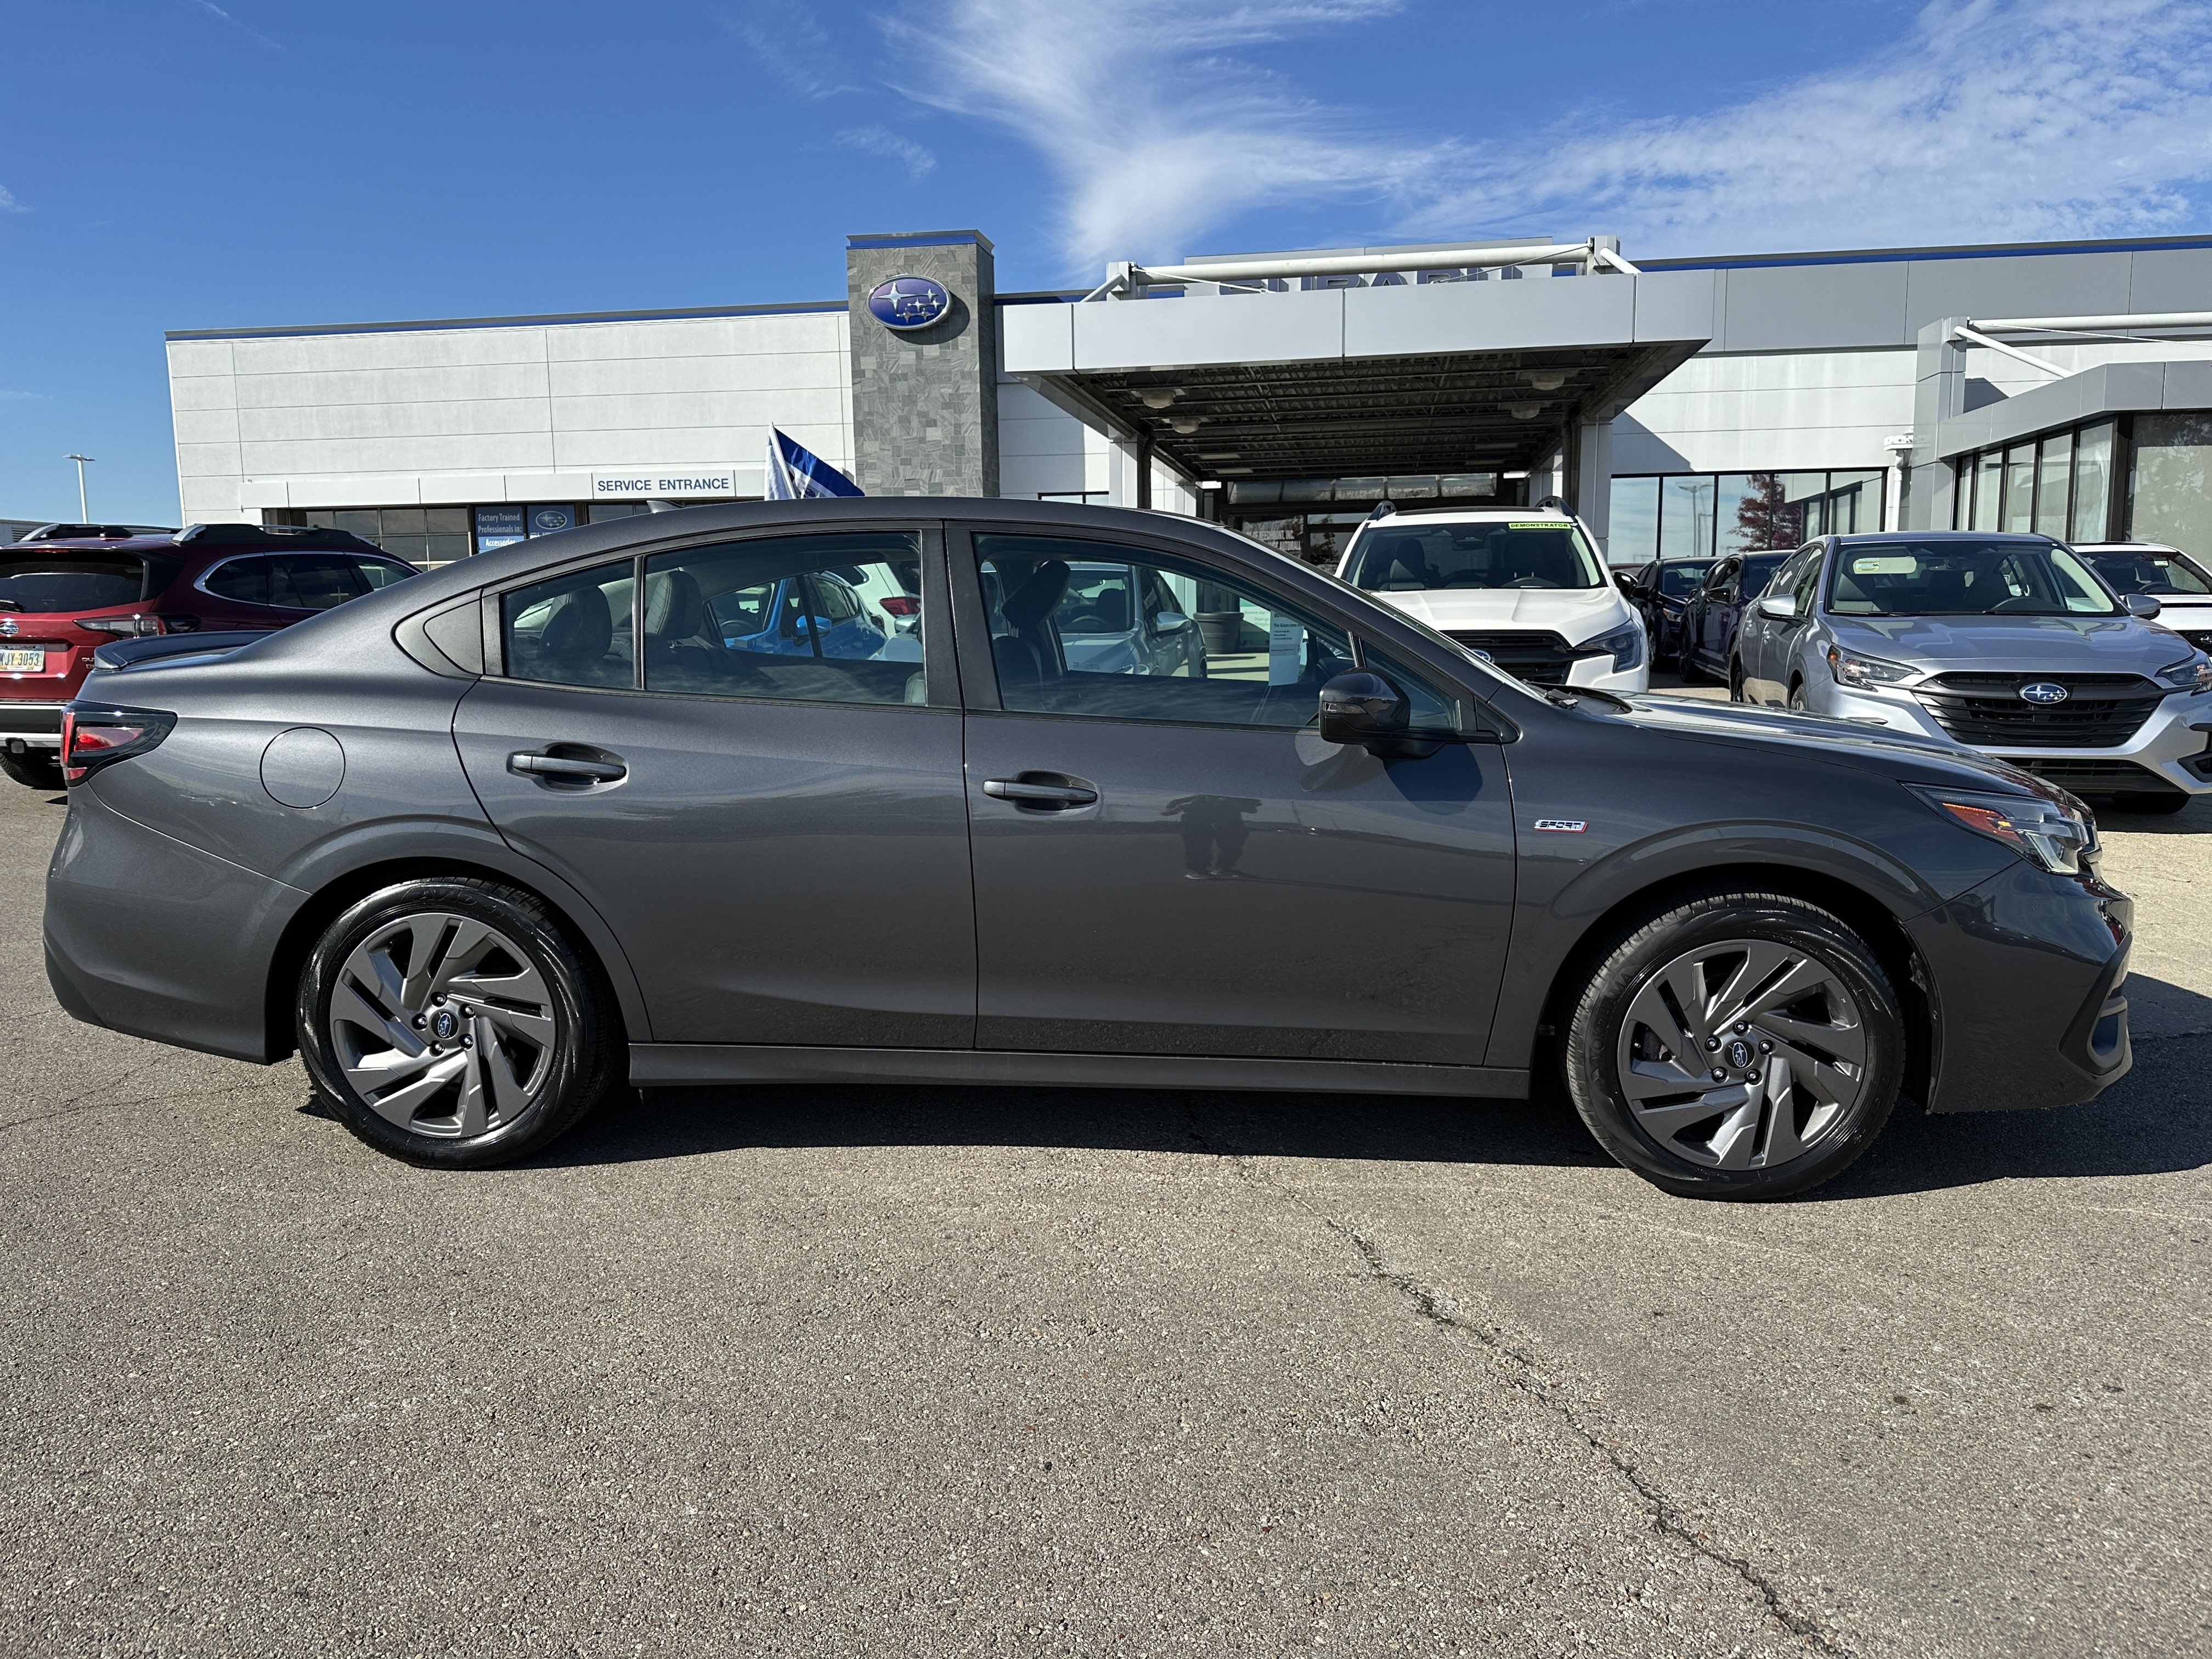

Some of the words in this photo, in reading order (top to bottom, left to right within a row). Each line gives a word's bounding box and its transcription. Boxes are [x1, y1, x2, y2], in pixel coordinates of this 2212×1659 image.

[597, 479, 652, 491] SERVICE
[658, 478, 729, 490] ENTRANCE
[478, 514, 499, 523] Factory
[499, 513, 520, 521] Trained
[478, 525, 514, 533] Professionals
[0, 652, 15, 666] KJY
[18, 652, 40, 666] 3053
[1539, 821, 1581, 830] SPORT
[1589, 972, 1634, 1062] YOKOHAMA
